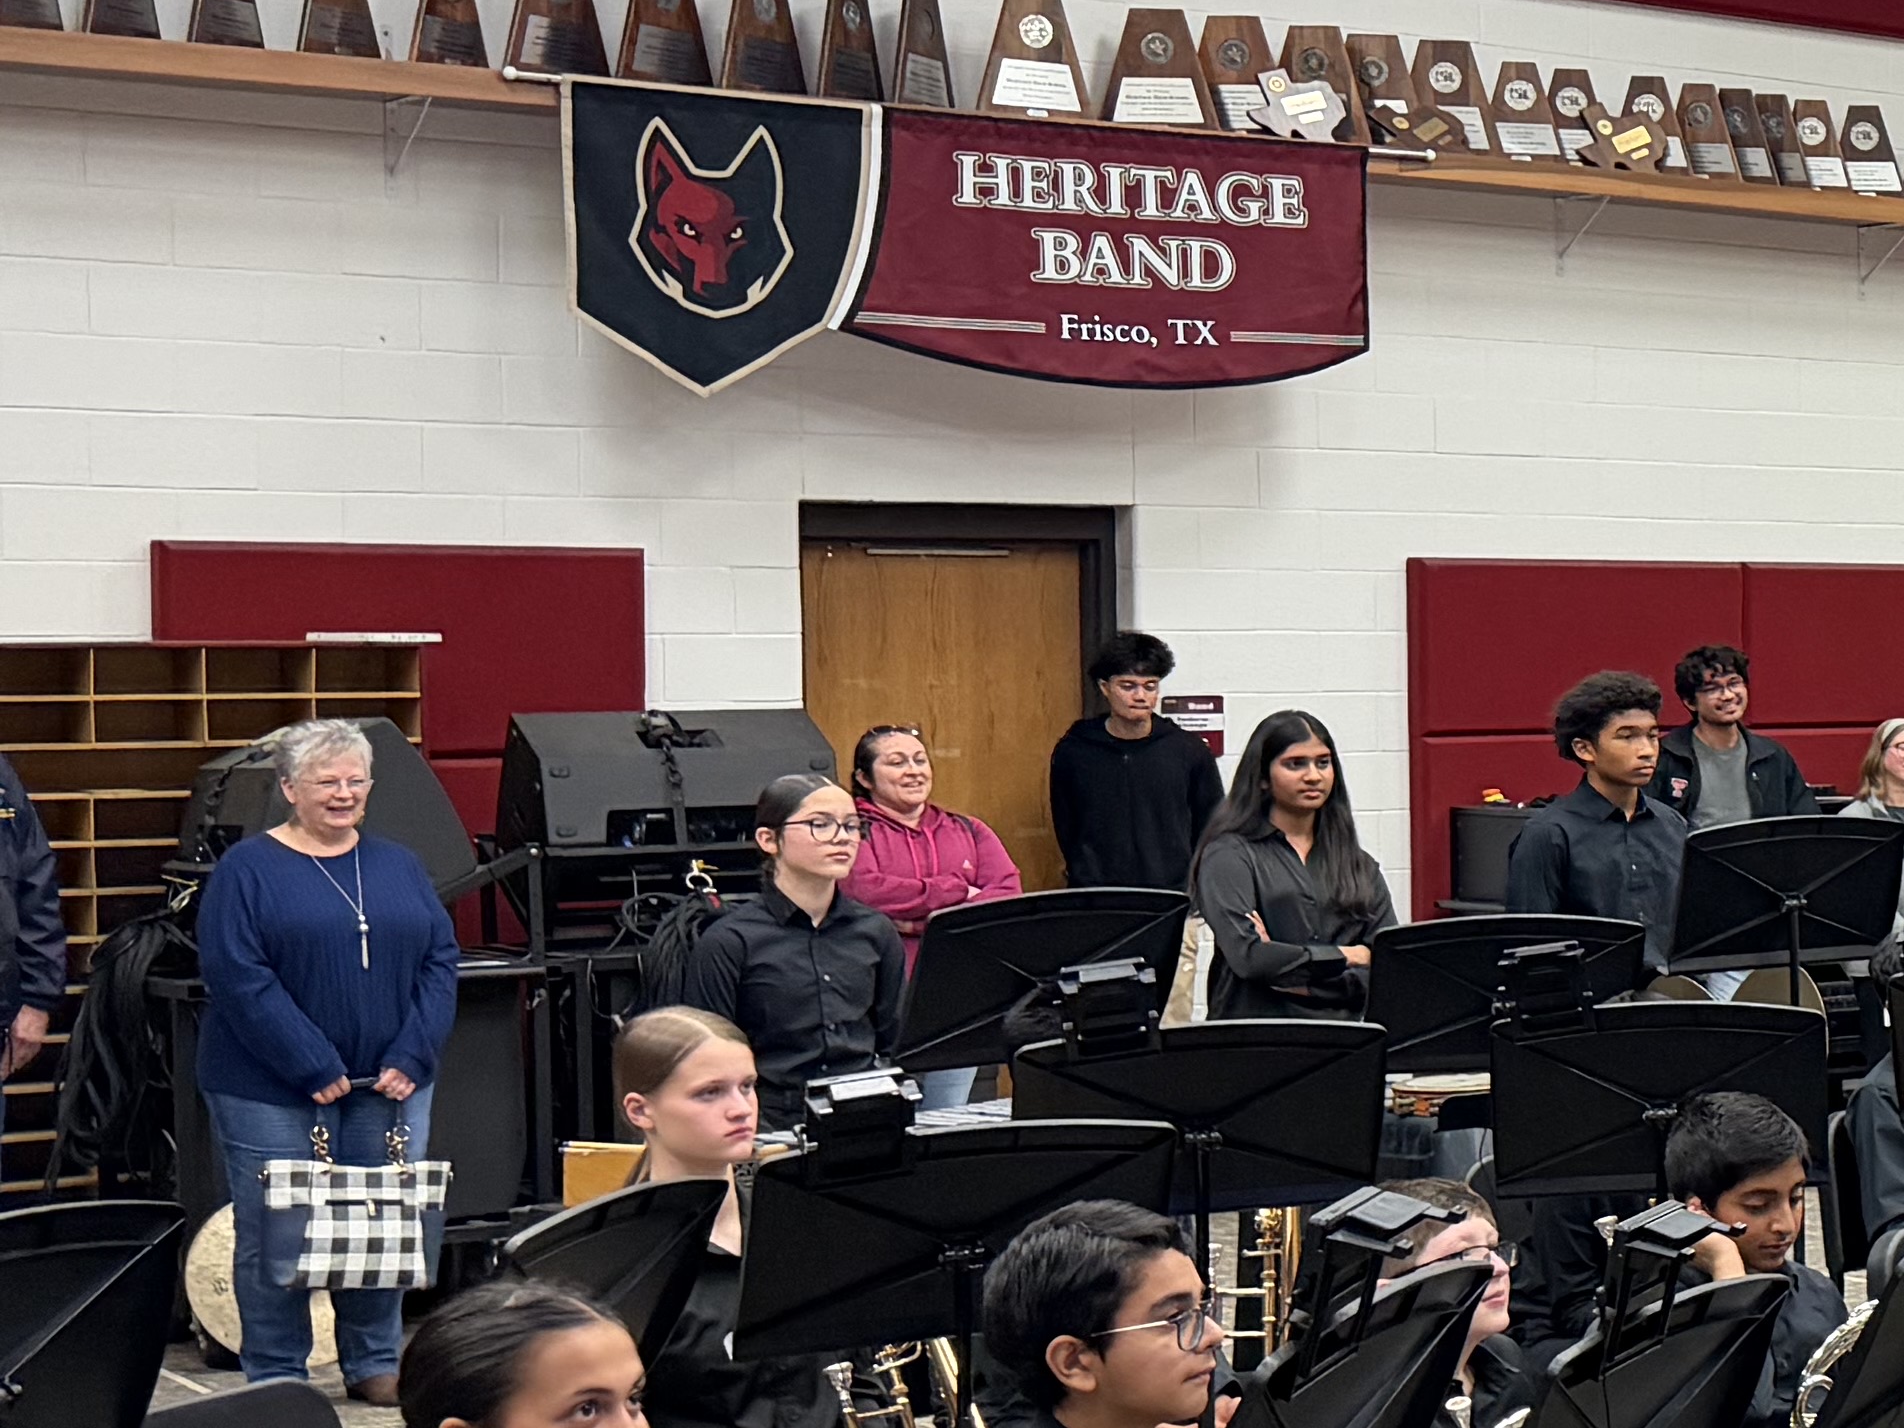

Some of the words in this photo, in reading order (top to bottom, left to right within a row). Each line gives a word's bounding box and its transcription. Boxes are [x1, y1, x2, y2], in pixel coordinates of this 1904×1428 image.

[952, 152, 1308, 227] HERITAGE
[1032, 228, 1236, 290] BAND
[1060, 313, 1159, 350] Frisco,
[1168, 319, 1220, 347] TX
